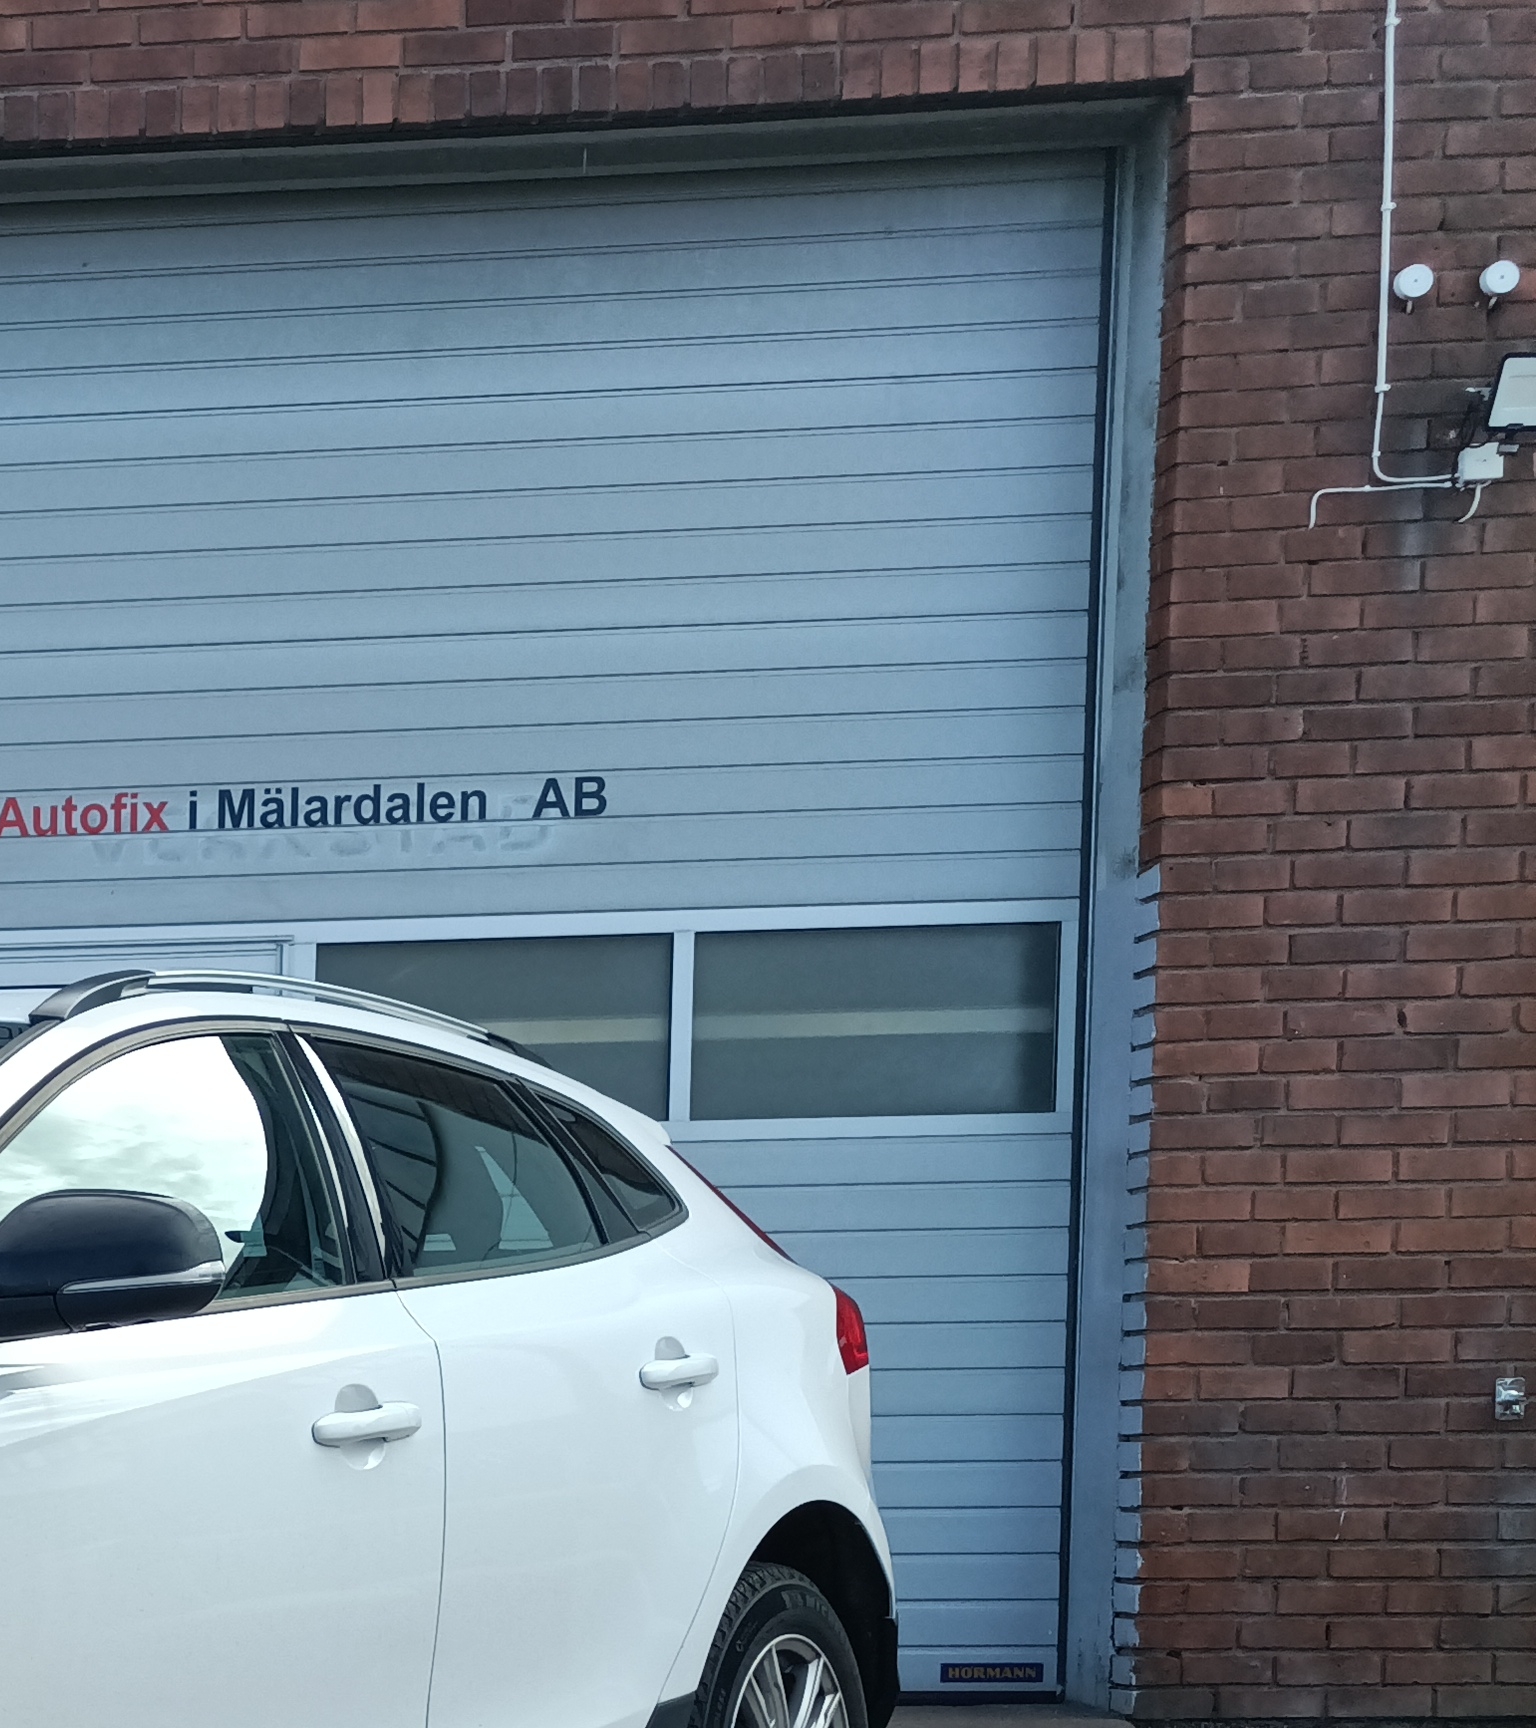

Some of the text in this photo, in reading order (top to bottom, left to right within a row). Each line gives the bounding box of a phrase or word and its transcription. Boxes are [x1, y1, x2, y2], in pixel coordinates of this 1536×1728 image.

[188, 789, 198, 831] i
[217, 782, 488, 830] Mälardalen
[531, 775, 608, 819] AB
